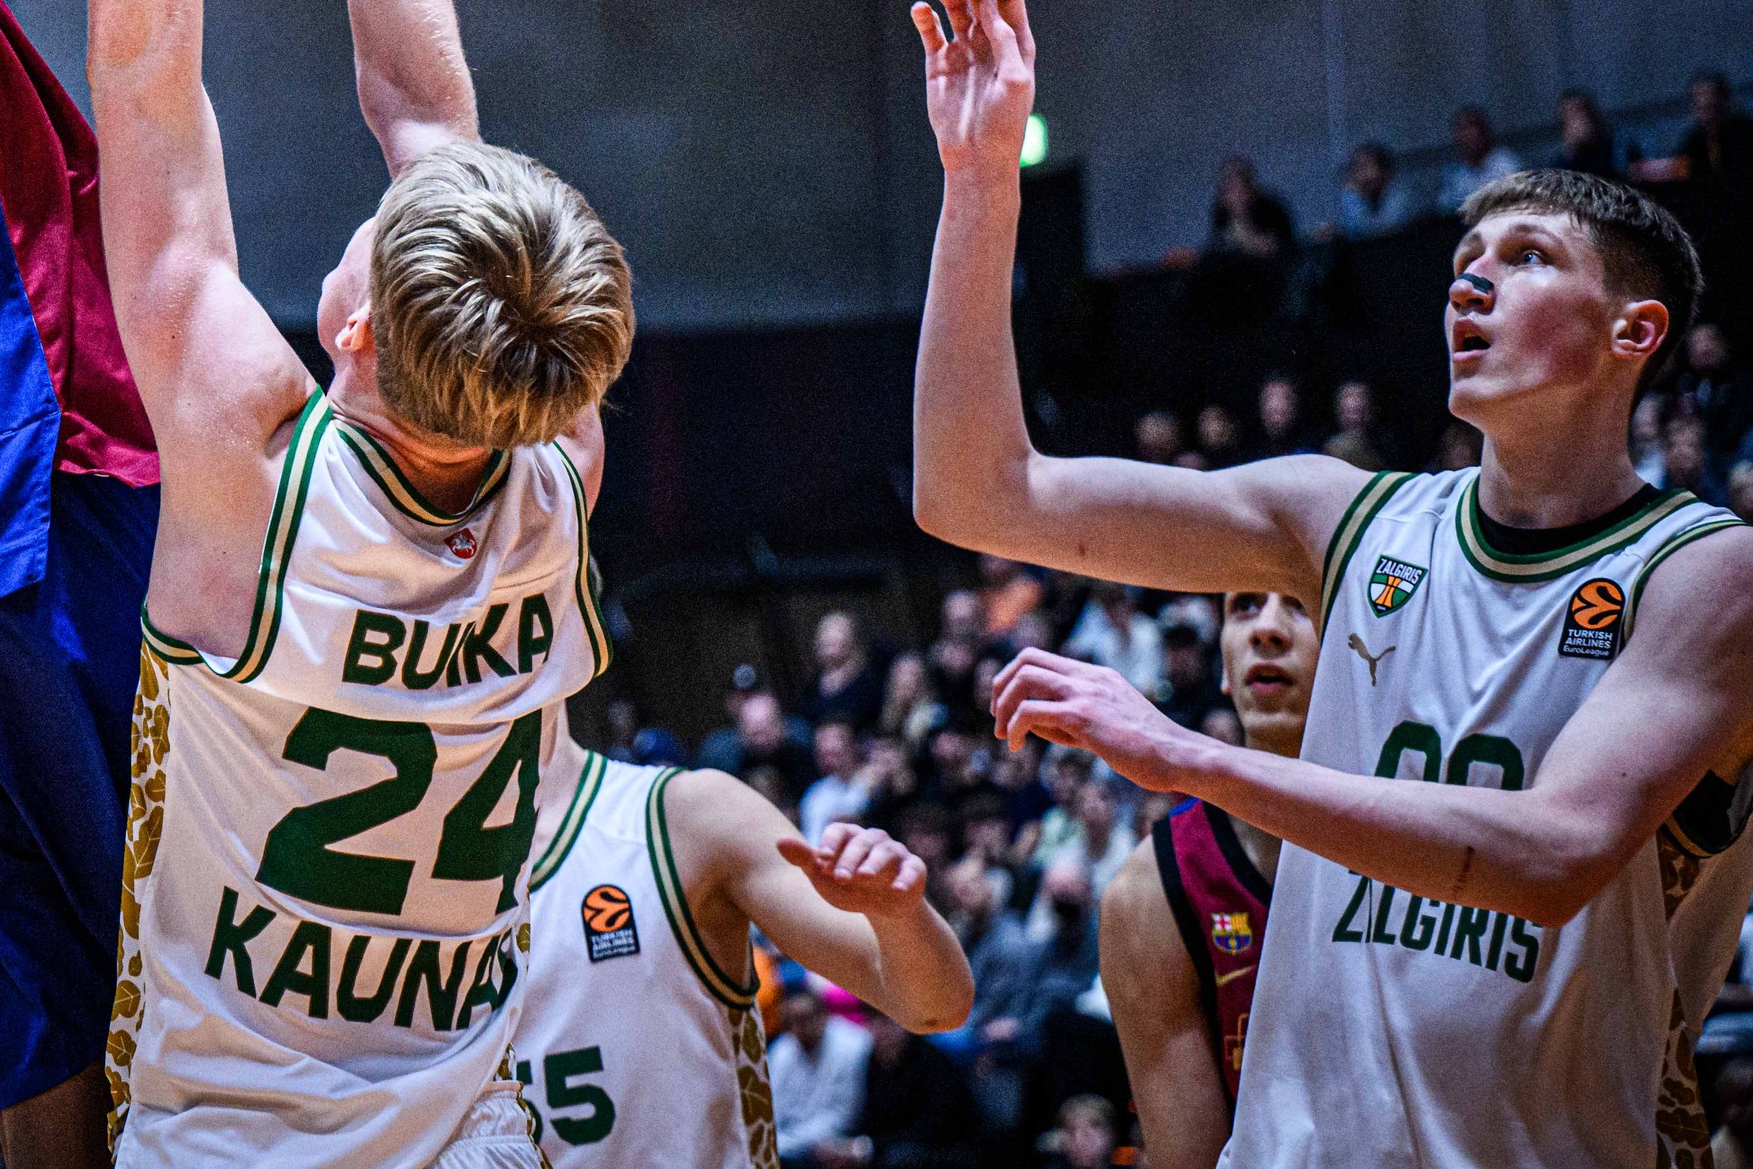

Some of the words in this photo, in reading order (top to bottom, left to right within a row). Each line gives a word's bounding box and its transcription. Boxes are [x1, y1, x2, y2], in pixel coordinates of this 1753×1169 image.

[342, 593, 553, 690] BUIKA
[1563, 645, 1609, 657] EuroLeague
[1565, 637, 1611, 649] AIRLINES
[1568, 629, 1613, 640] TURKISH
[255, 706, 542, 915] 24
[1332, 867, 1543, 983] ZLGIRIS
